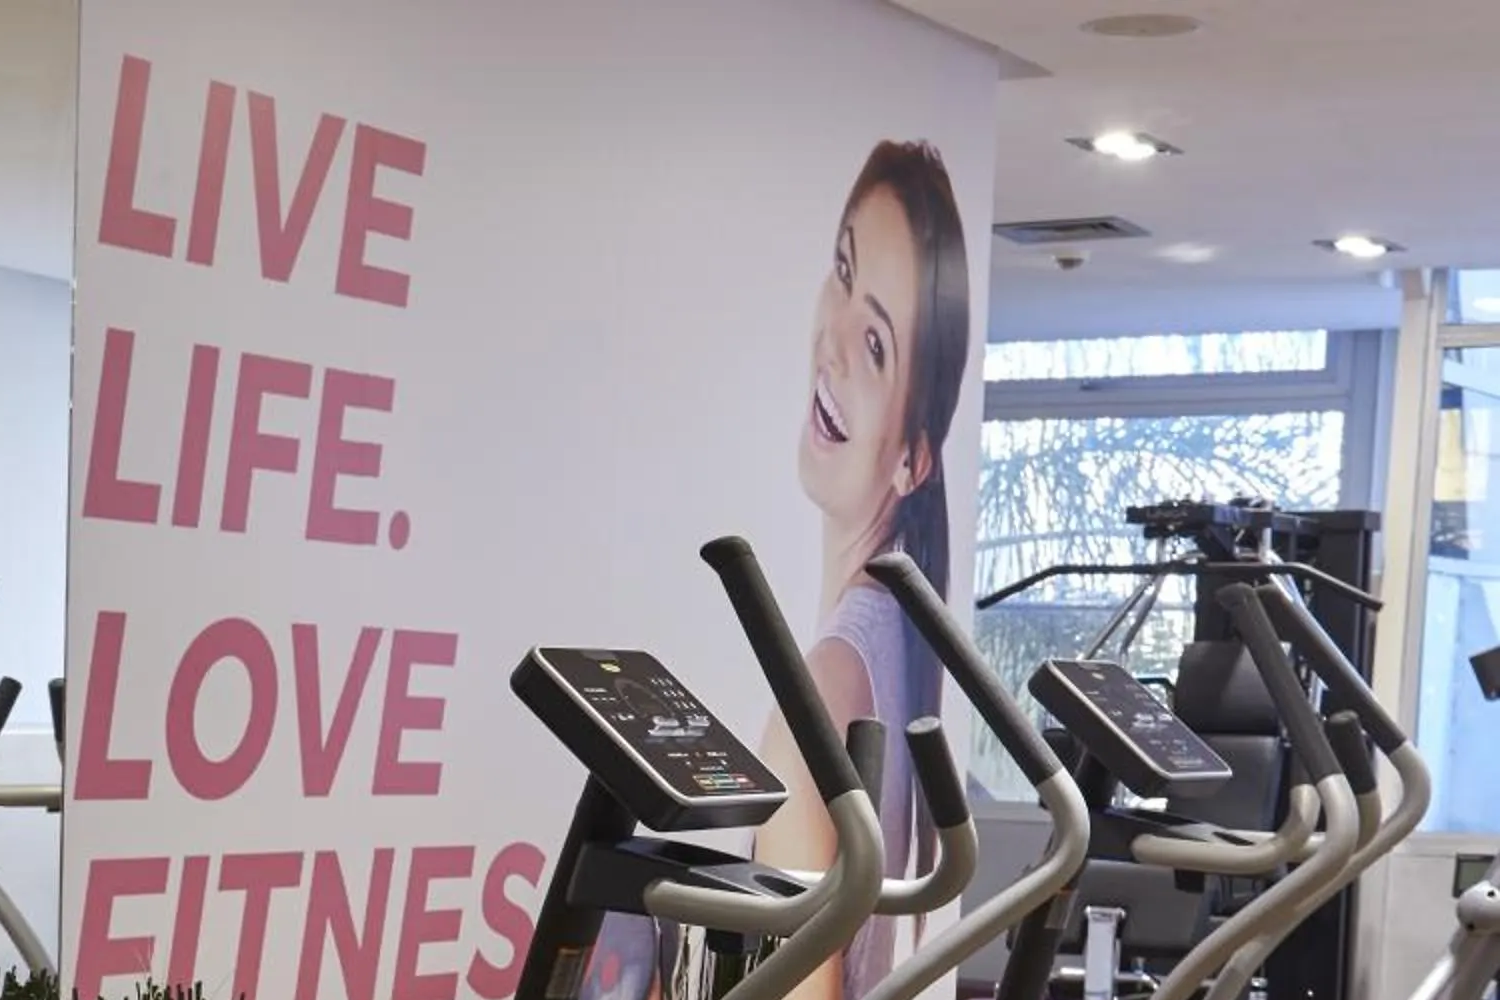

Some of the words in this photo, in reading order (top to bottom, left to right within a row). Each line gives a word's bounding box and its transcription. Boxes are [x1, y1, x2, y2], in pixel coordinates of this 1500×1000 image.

[98, 53, 427, 308] LIVE
[82, 327, 411, 550] LIFE.
[73, 610, 459, 800] LOVE
